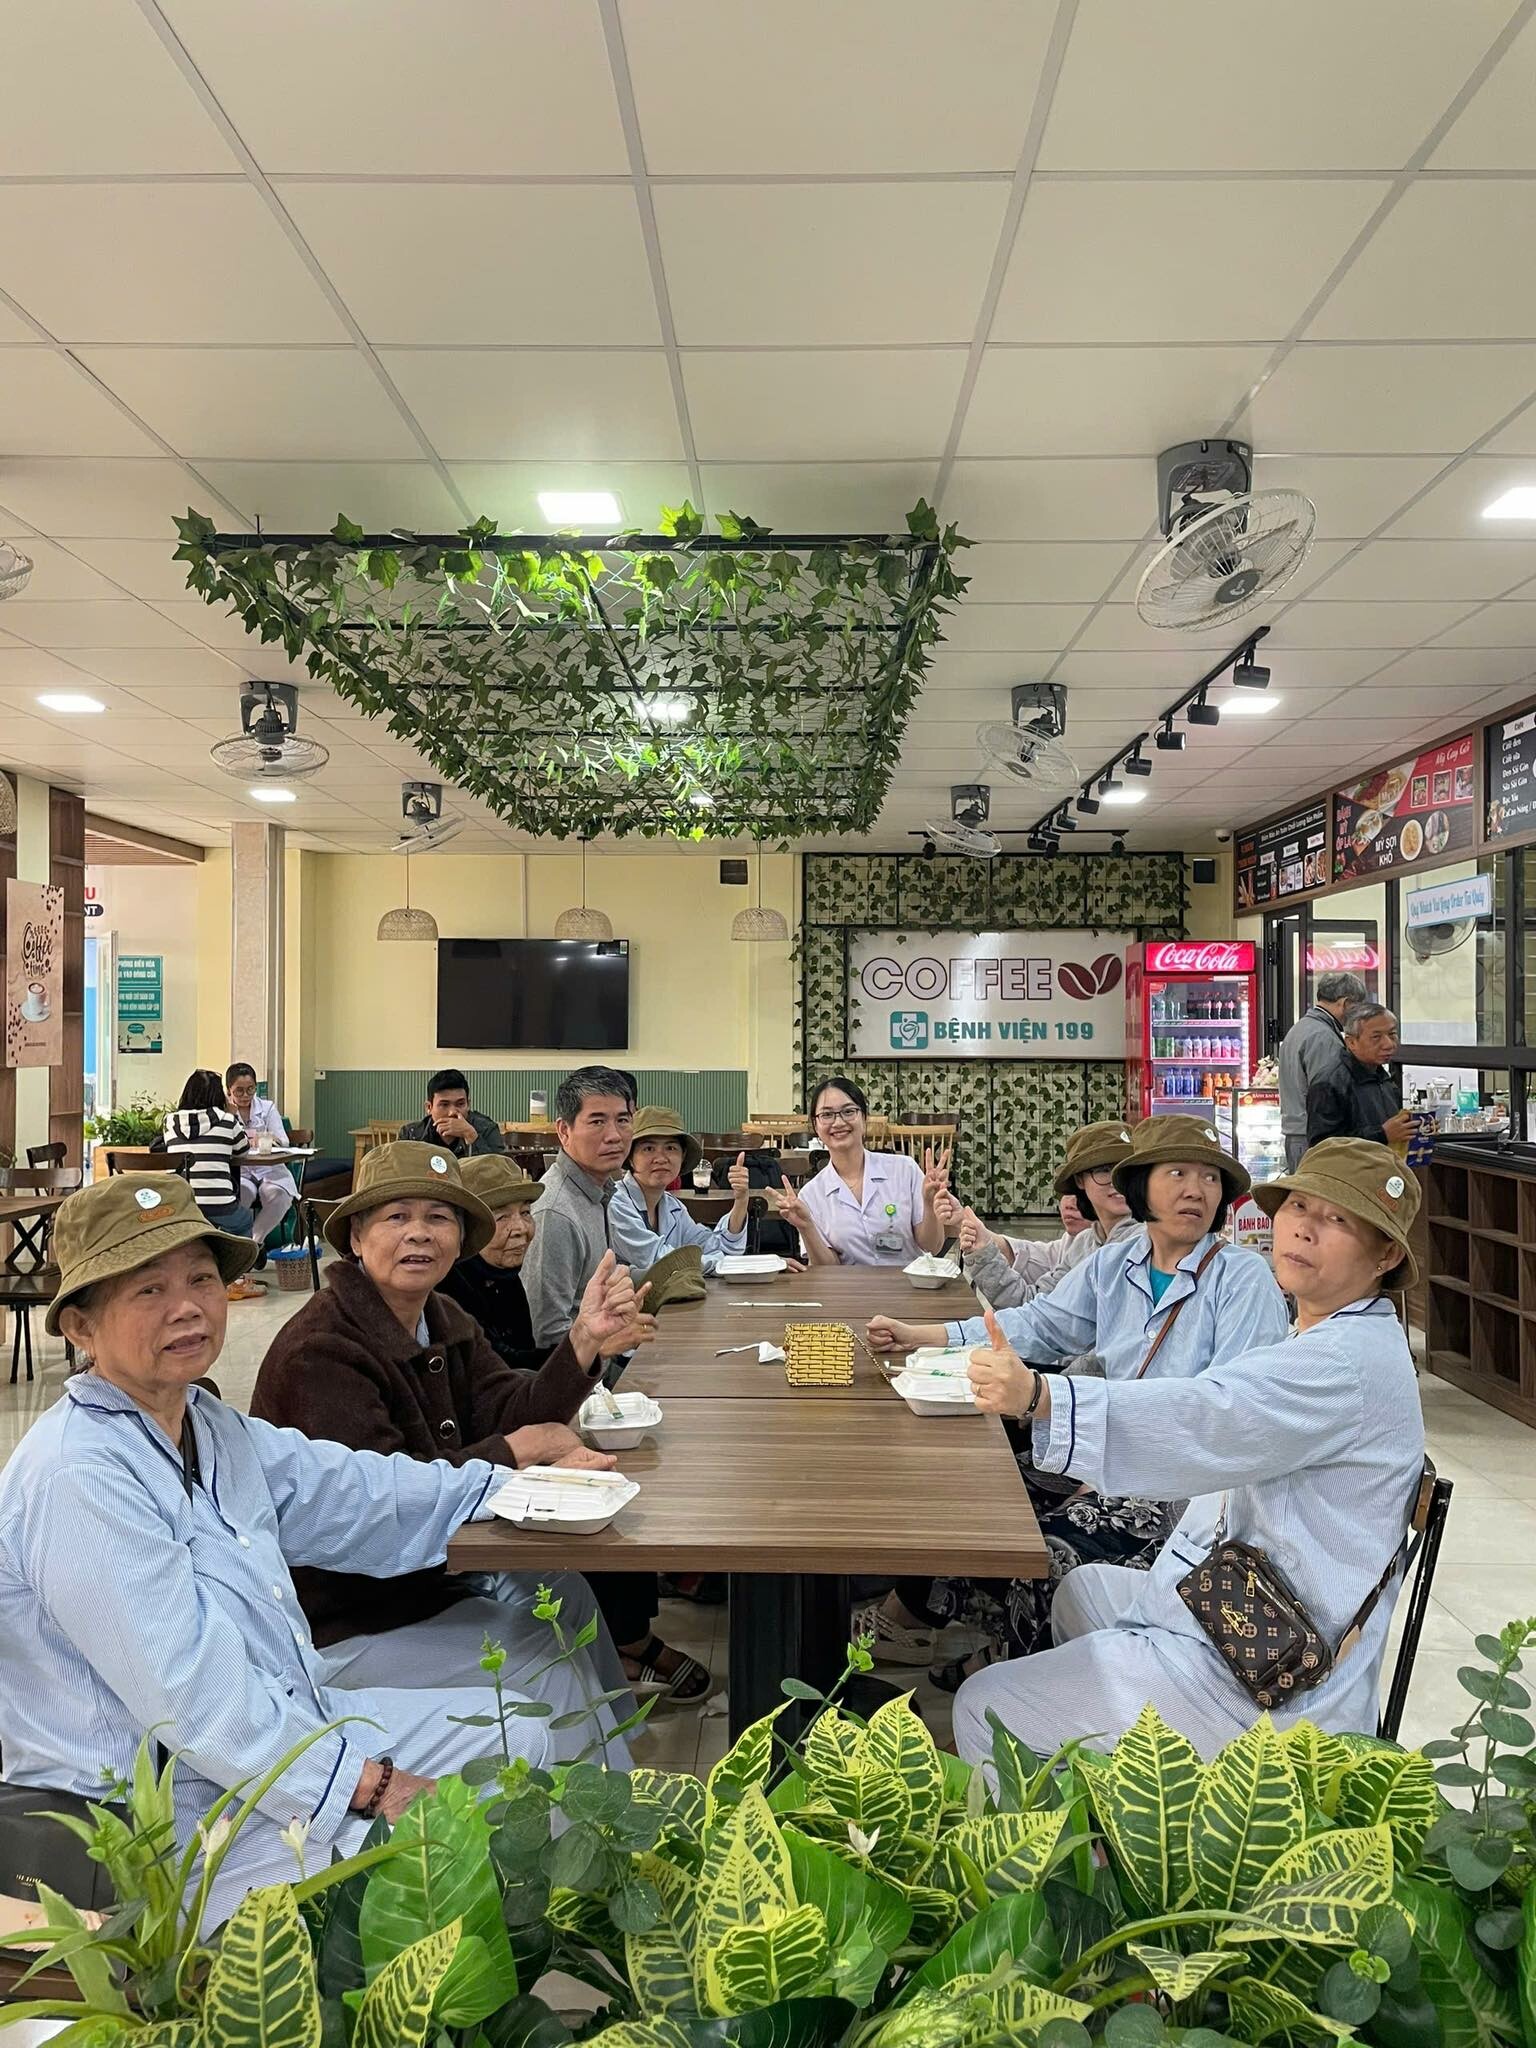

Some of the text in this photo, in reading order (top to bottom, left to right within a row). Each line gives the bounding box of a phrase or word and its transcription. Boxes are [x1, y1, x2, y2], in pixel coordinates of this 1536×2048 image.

[861, 957, 1052, 1000] COFFEE
[934, 1018, 1094, 1043] BỆNH VIỆN 199
[1239, 1217, 1270, 1232] BÁNH BAO
